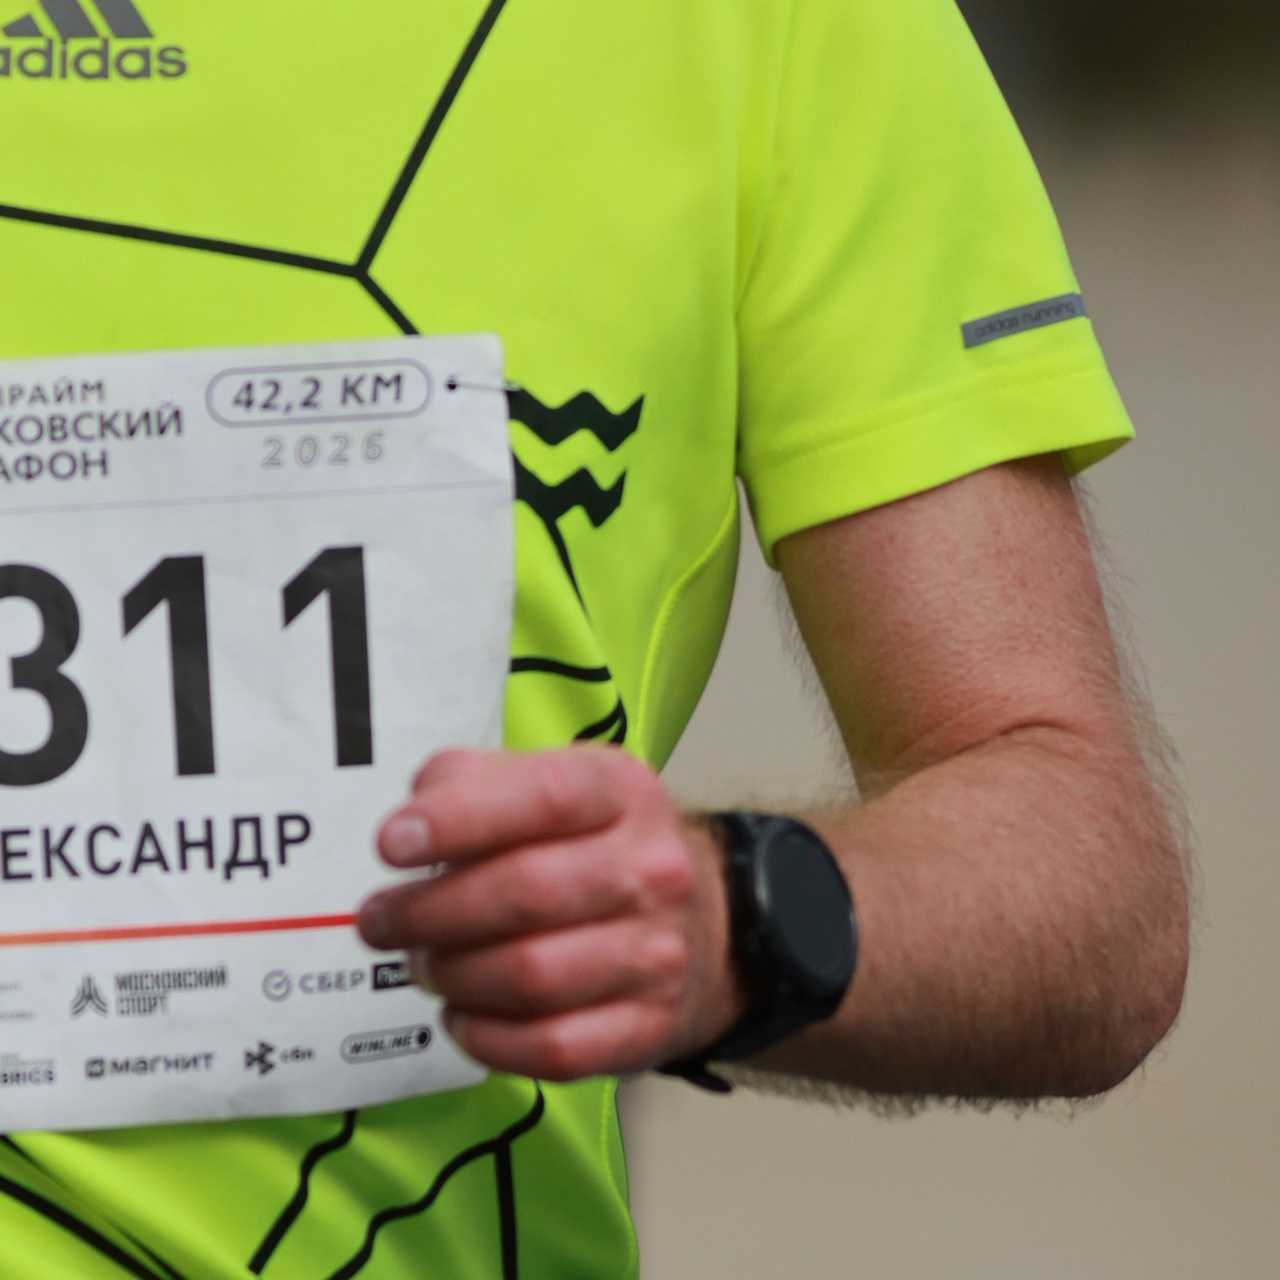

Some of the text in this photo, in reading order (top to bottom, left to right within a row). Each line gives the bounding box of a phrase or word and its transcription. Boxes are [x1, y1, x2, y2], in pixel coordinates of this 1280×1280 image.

[233, 373, 403, 414] 42,2 КМ
[261, 431, 385, 470] 2026
[115, 963, 228, 993] МОСКОВСКИЙ
[299, 969, 365, 996] СБЕР
[116, 994, 170, 1017] СПОРТ
